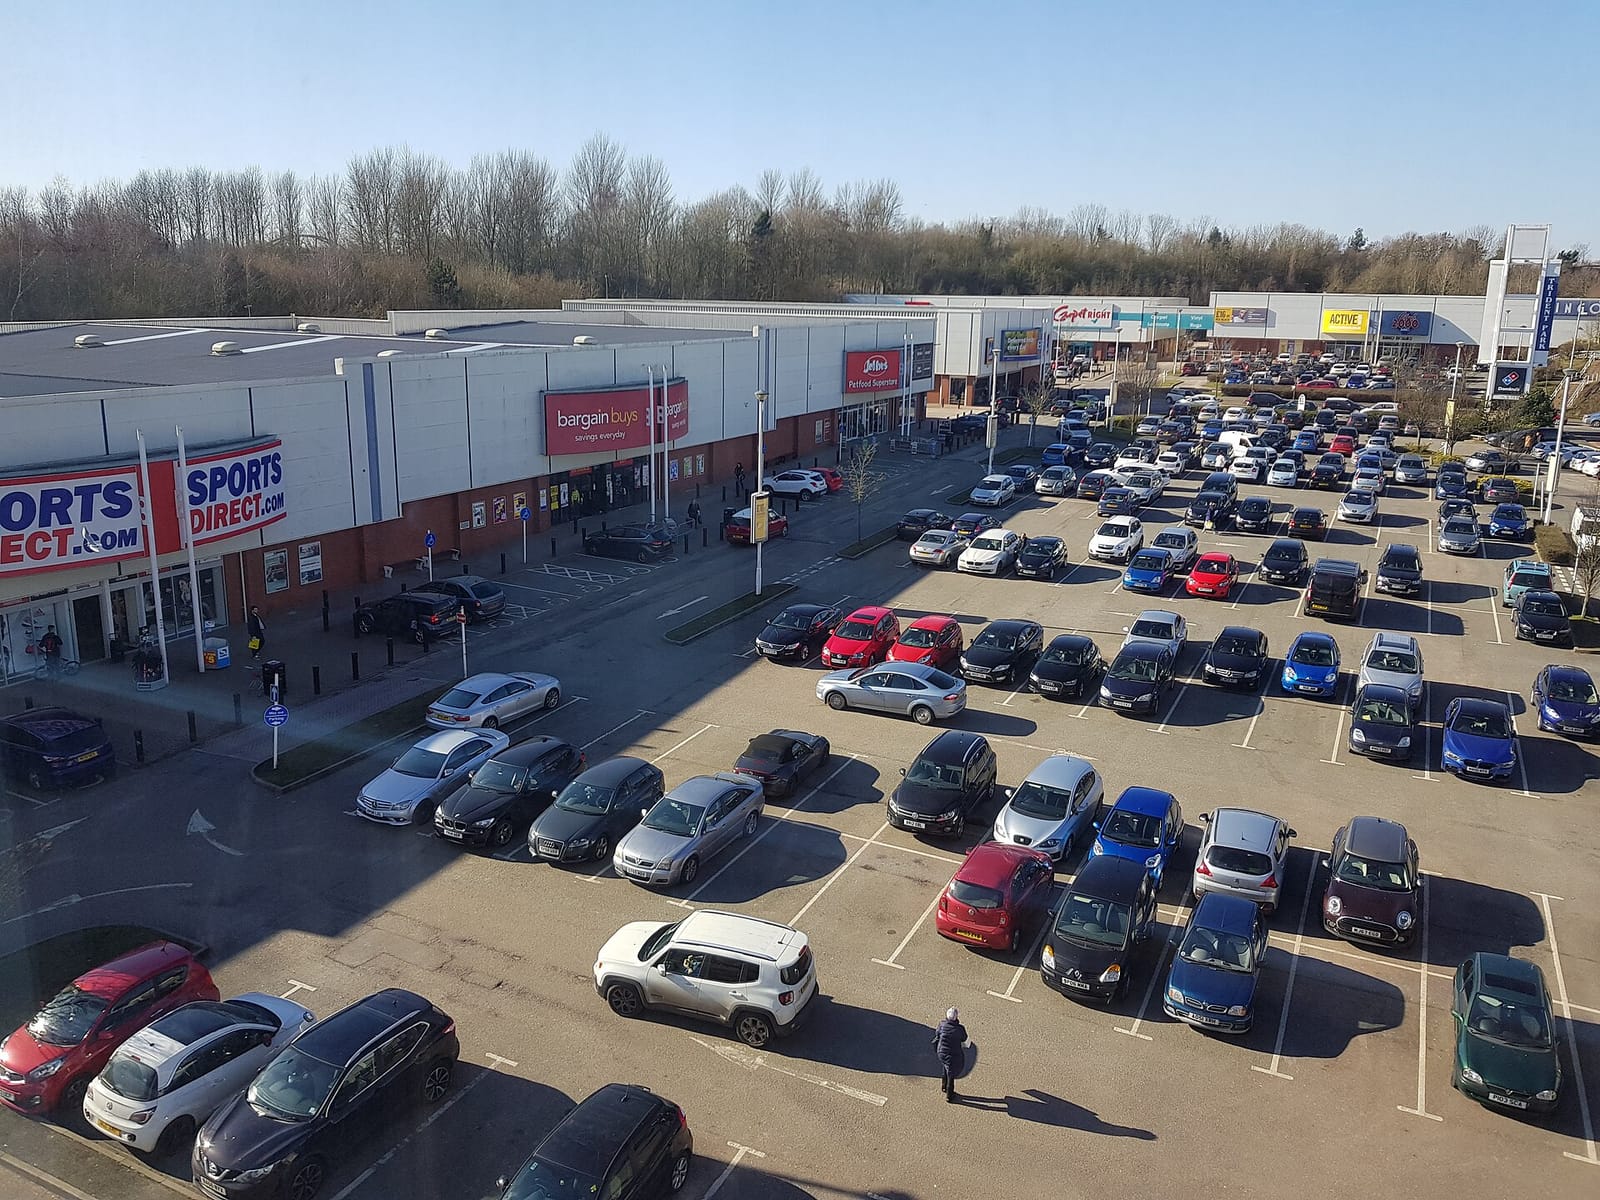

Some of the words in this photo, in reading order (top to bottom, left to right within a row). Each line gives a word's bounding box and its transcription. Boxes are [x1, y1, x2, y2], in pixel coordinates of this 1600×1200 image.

[1543, 277, 1555, 321] TRIDENT
[1538, 325, 1549, 350] PARK
[848, 379, 872, 389] Petfood
[557, 409, 609, 430] bargain
[611, 406, 638, 426] buys
[575, 433, 598, 443] savings
[600, 430, 626, 441] everyday
[187, 452, 282, 506] SPORTS
[0, 481, 133, 531] ORTS
[190, 492, 284, 535] DIRECT.COM
